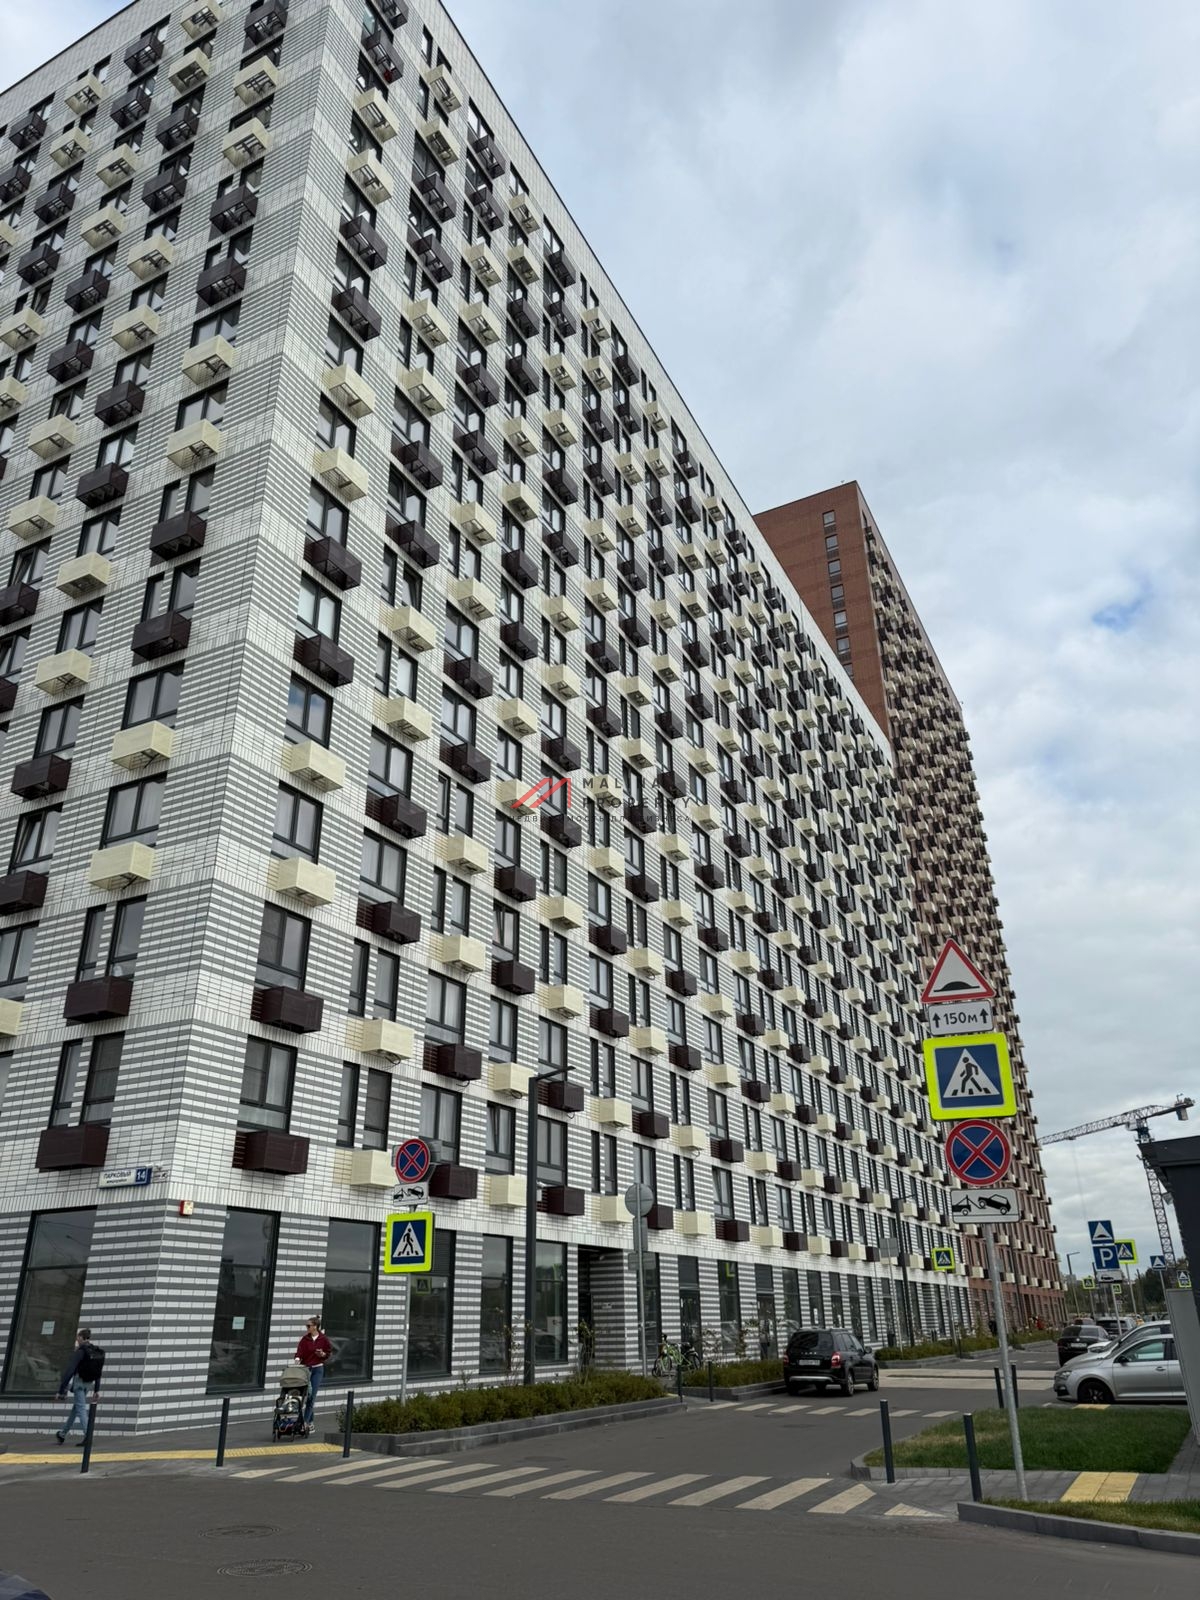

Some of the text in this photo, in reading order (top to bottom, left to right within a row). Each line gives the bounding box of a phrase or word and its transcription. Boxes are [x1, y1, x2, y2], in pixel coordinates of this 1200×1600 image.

[943, 1012, 977, 1025] 150м
[136, 1171, 146, 1180] 14
[1100, 1248, 1113, 1267] P
